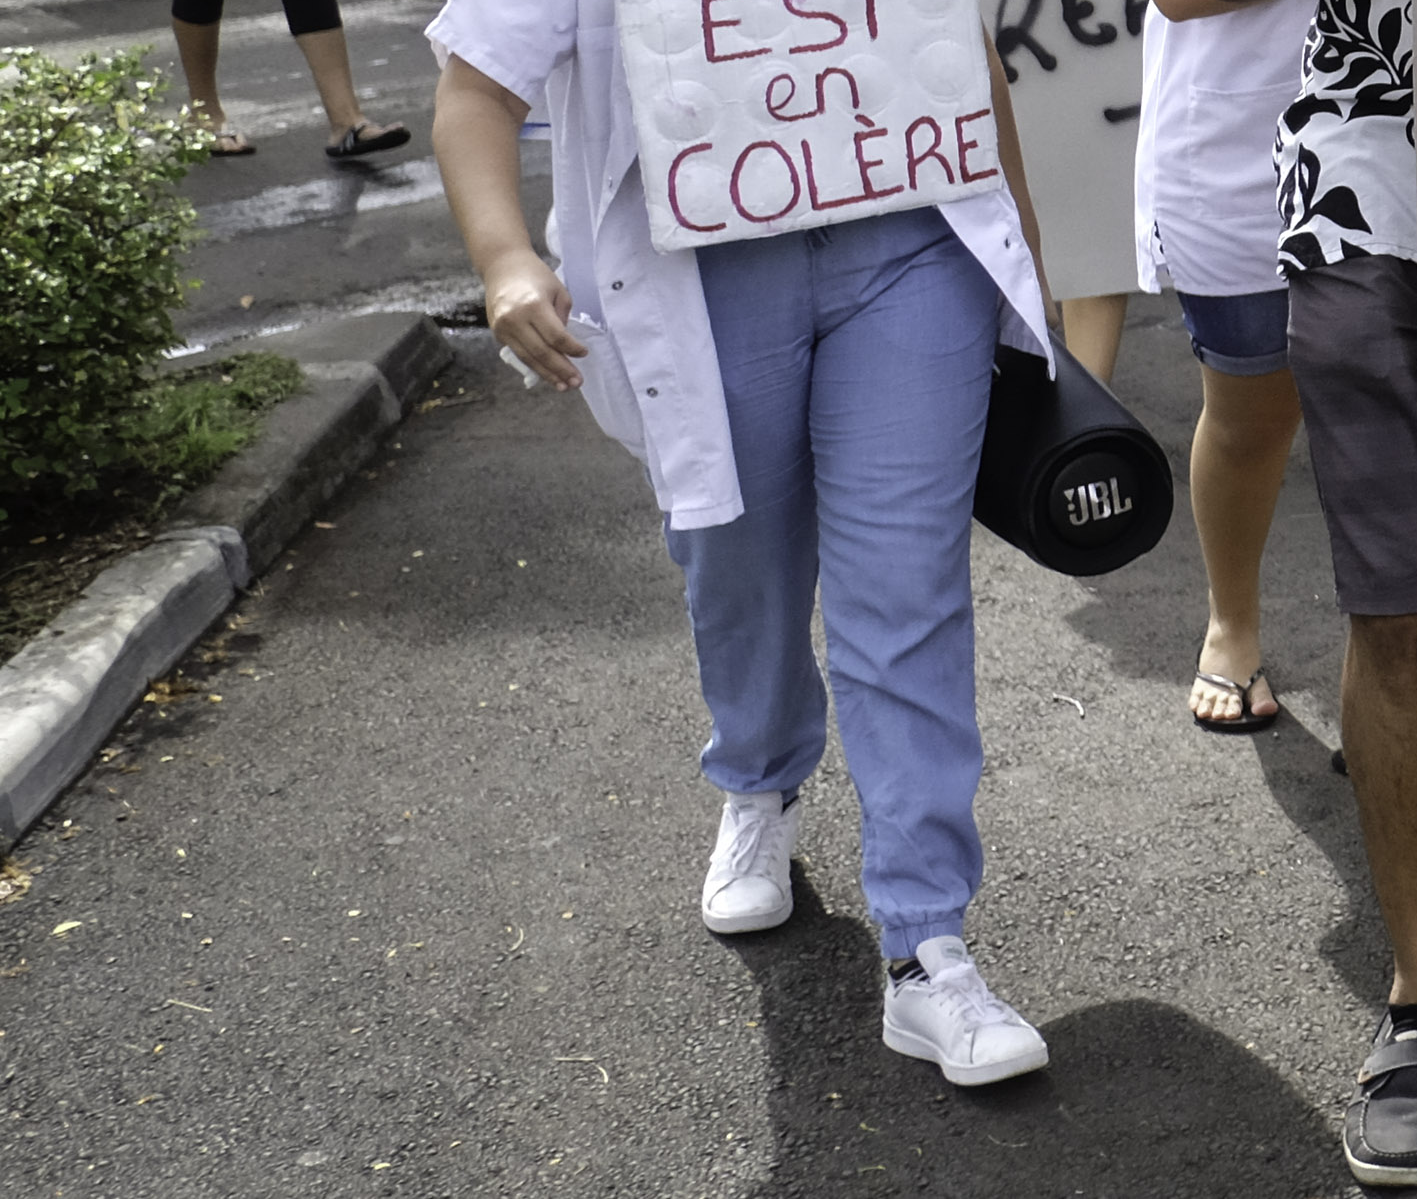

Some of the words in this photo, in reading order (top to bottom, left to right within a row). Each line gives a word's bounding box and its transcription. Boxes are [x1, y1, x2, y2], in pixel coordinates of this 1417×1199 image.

[765, 67, 861, 122] en
[667, 108, 999, 232] COLÈRE
[1064, 477, 1133, 527] JBL
